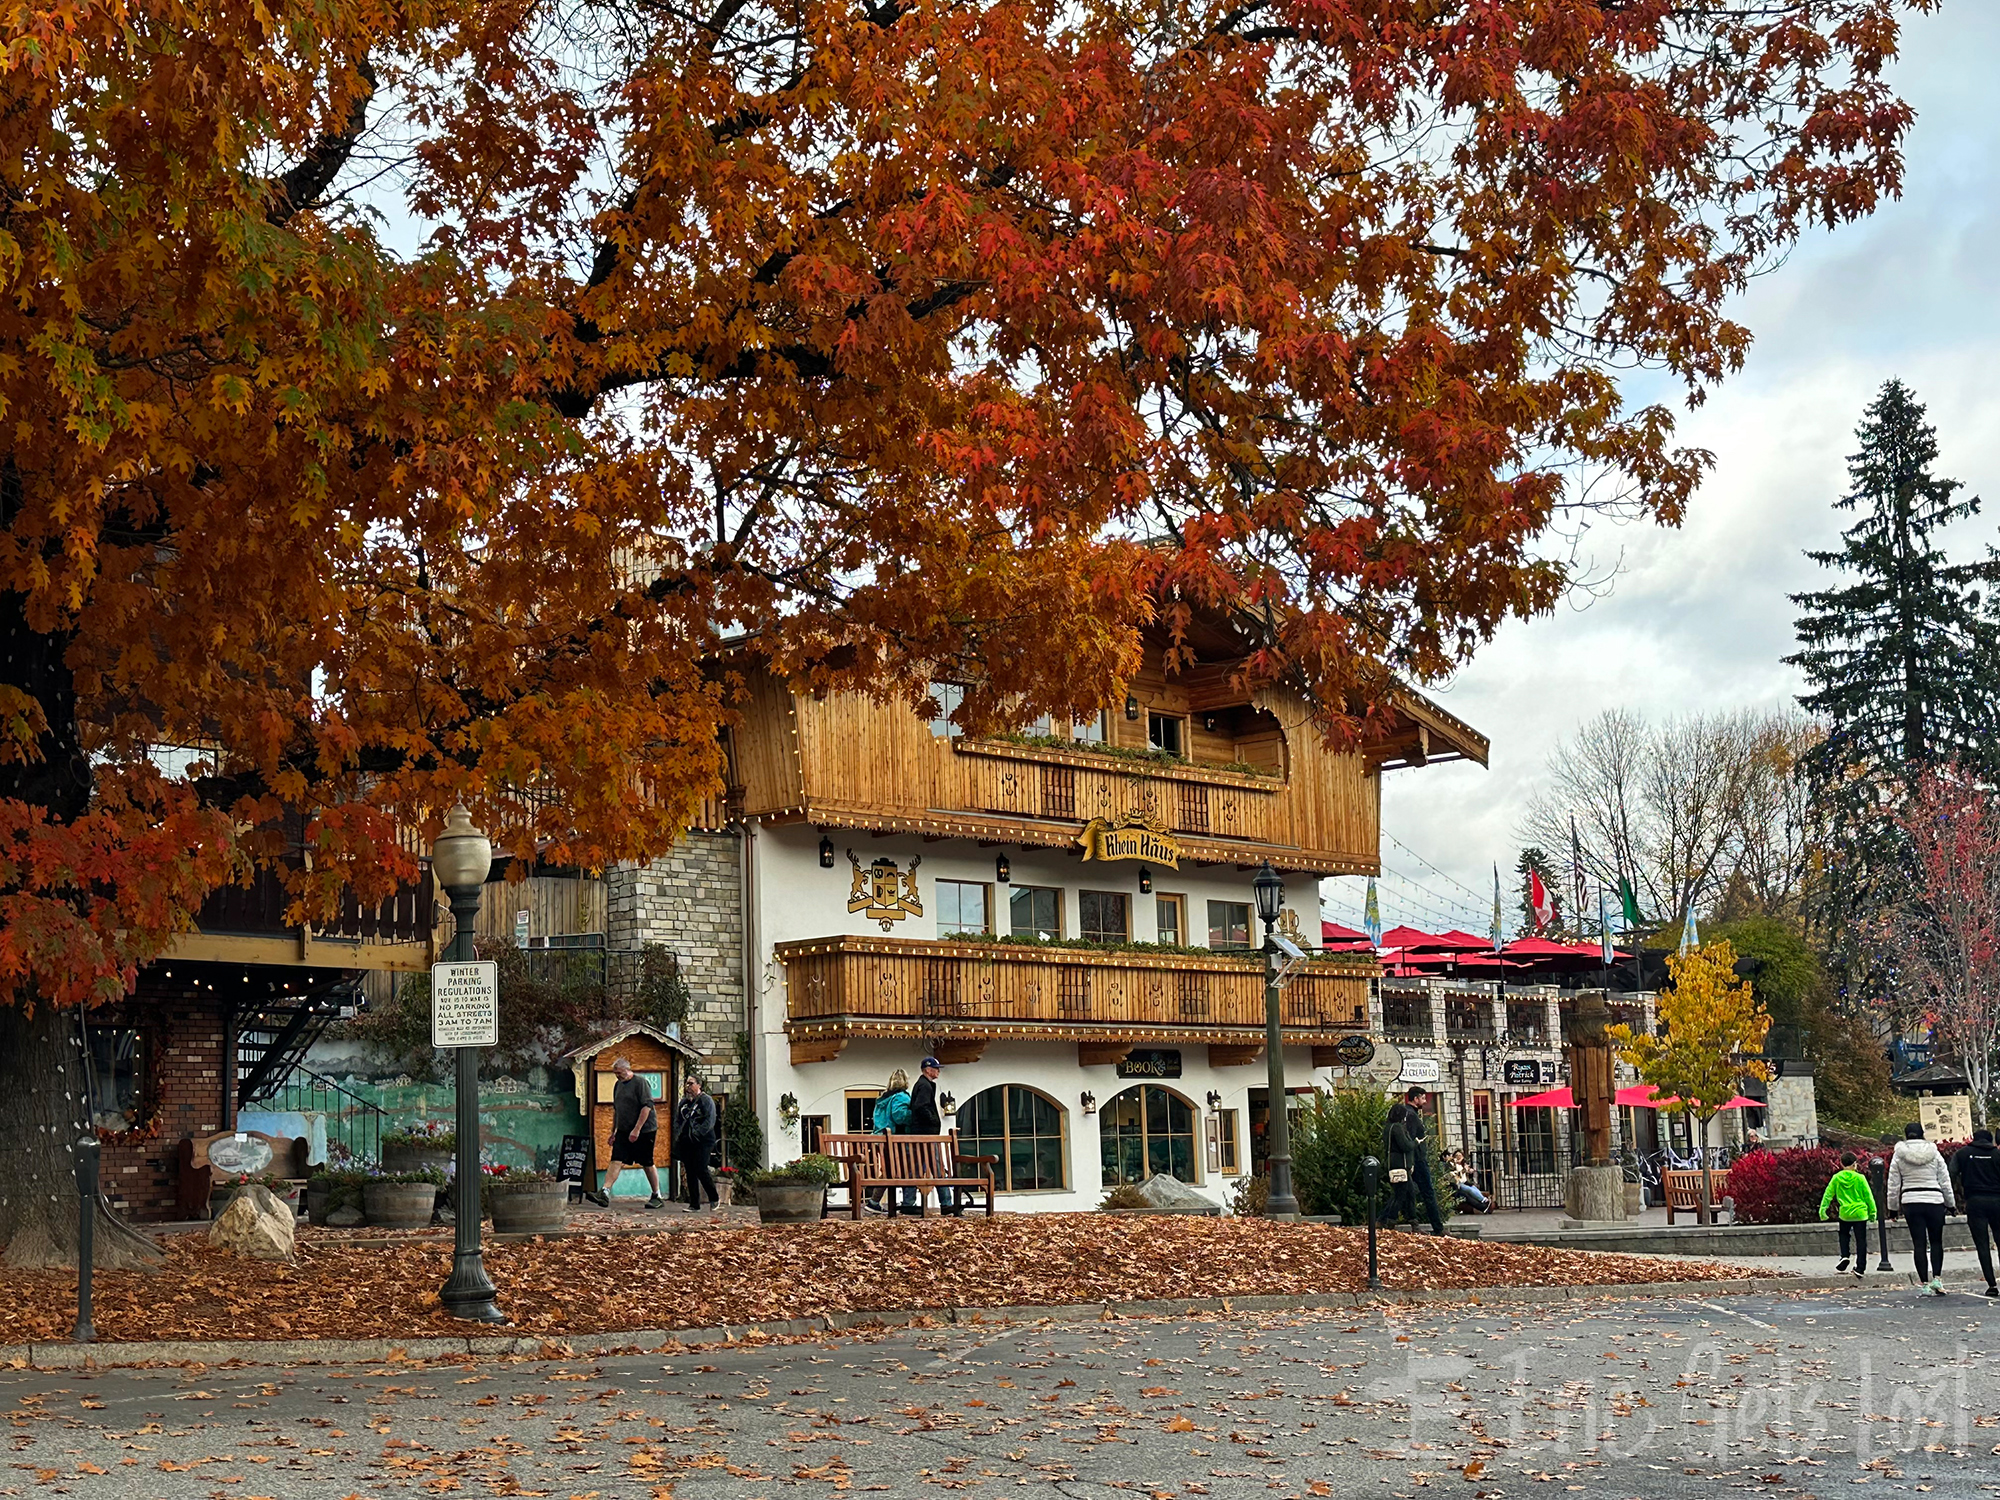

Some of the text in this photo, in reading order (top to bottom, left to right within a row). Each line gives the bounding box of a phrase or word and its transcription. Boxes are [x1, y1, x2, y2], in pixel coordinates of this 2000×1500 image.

[1105, 833, 1137, 857] Rhein
[450, 967, 479, 976] WINTER
[447, 977, 482, 986] PARKING
[437, 986, 492, 996] REGULATIONS
